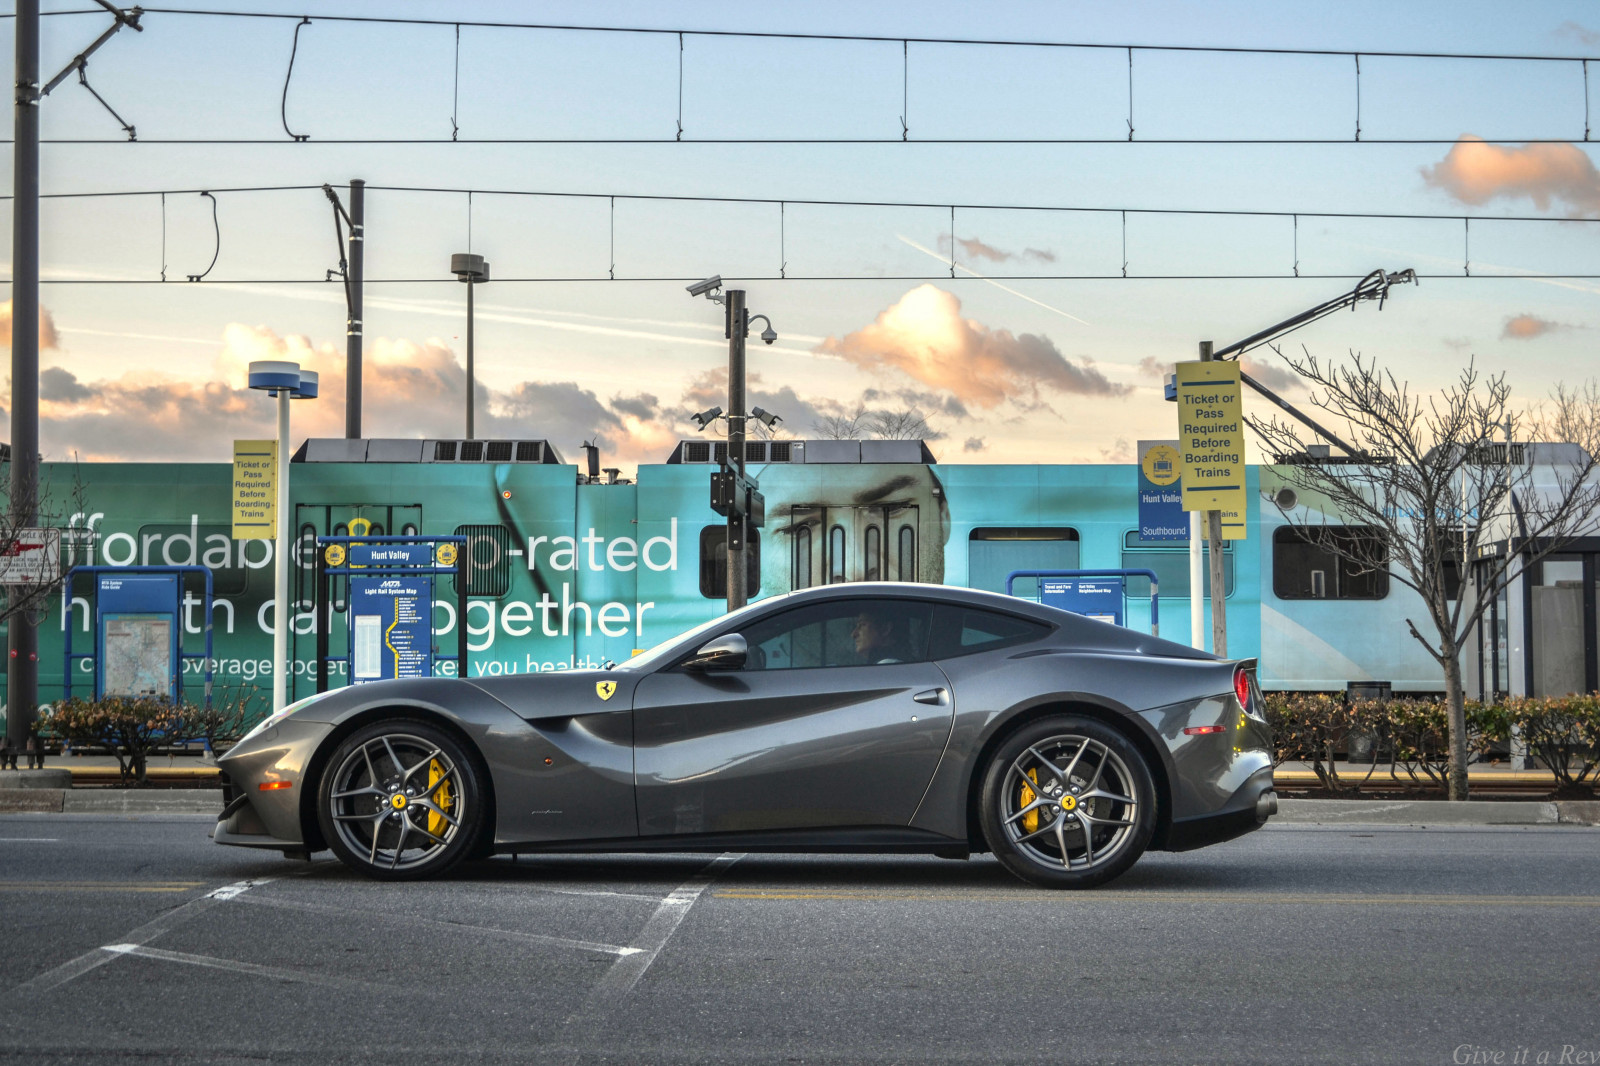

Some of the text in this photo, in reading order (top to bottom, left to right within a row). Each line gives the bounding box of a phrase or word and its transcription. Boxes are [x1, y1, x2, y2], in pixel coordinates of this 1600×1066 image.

[1183, 394, 1235, 404] Ticket or
[1196, 409, 1224, 419] Pass
[1184, 422, 1237, 435] Required
[1192, 438, 1231, 448] Before
[1185, 452, 1239, 464] Boarding
[1194, 467, 1231, 478] Trains
[235, 480, 271, 489] Required
[240, 490, 266, 498] Before
[1142, 494, 1160, 503] Hunt
[235, 500, 271, 509] Boarding
[241, 510, 264, 518] Trains
[1221, 510, 1238, 518] ains
[1142, 526, 1186, 536] Southbound
[371, 550, 410, 561] Hunt Valley
[431, 583, 655, 652] ogether
[182, 656, 272, 680] overage
[475, 660, 518, 677] you
